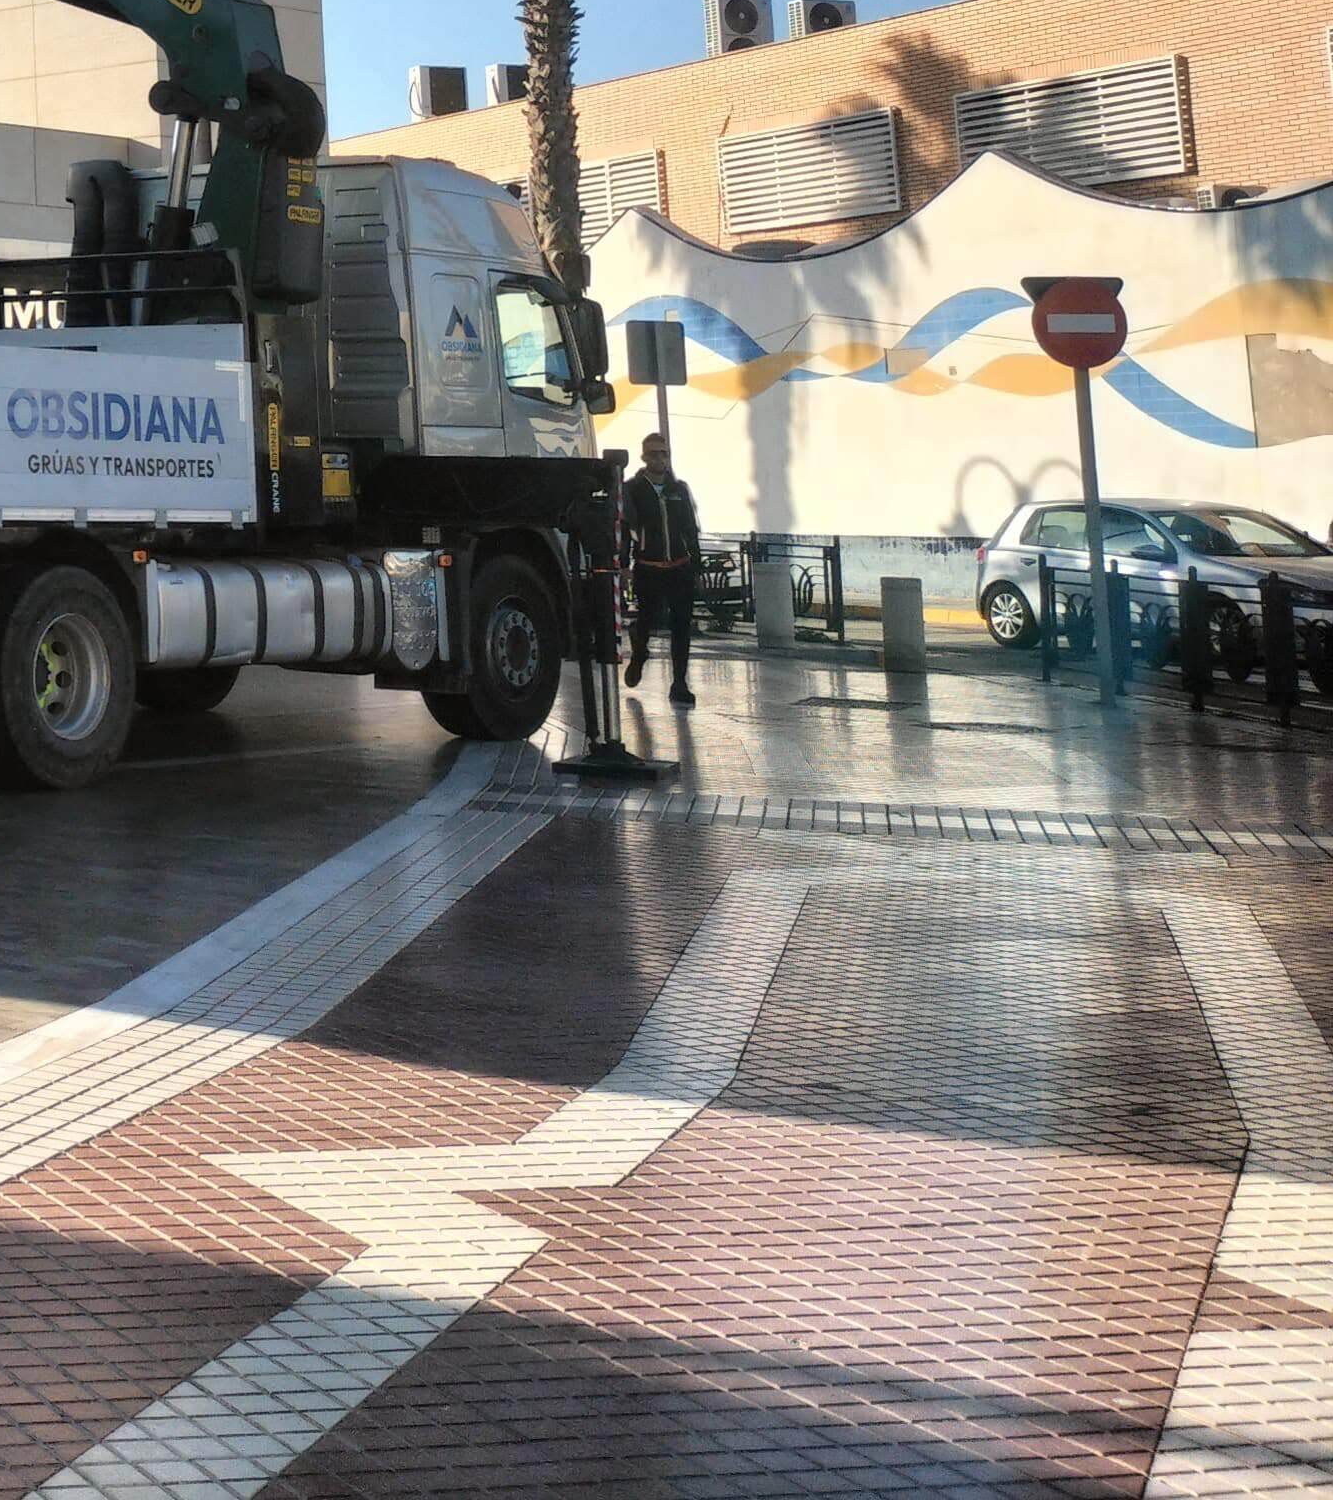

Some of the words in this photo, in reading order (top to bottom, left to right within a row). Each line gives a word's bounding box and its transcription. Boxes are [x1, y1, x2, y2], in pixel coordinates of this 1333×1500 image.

[6, 387, 226, 445] OBSIDIANA
[28, 448, 85, 476] GRÚAS
[90, 456, 100, 476] Y
[104, 456, 215, 478] TRANSPORTES
